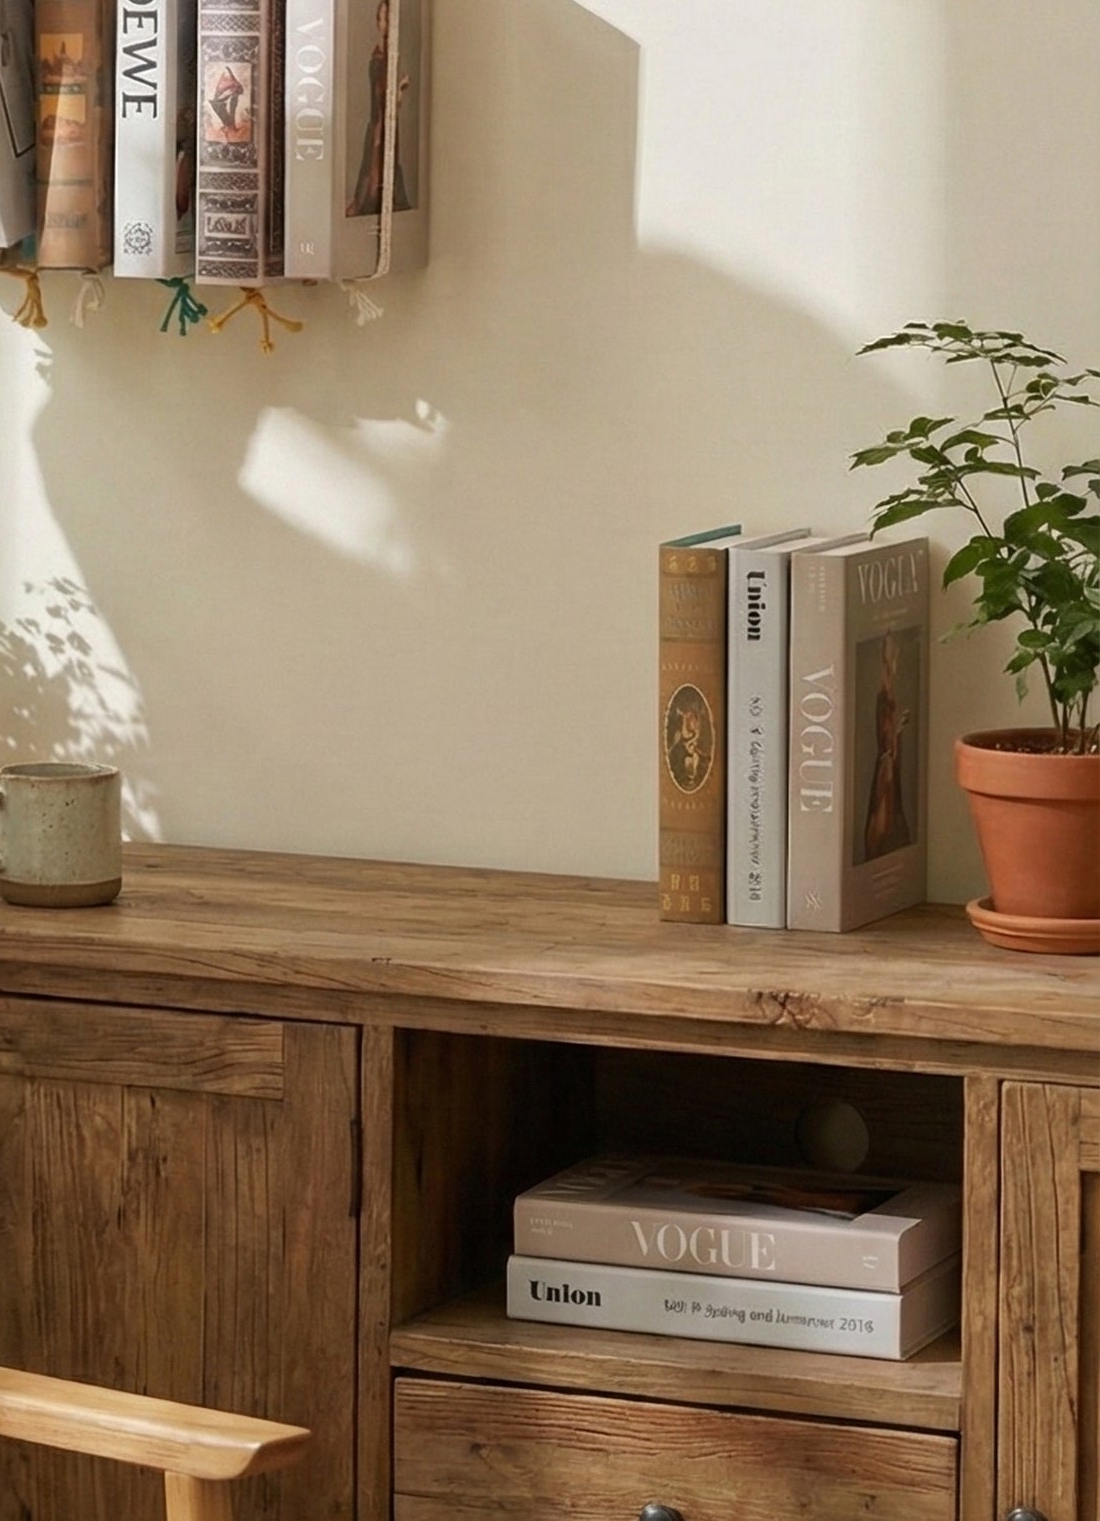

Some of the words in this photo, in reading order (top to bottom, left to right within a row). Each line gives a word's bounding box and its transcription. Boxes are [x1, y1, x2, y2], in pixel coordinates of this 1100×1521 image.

[295, 17, 326, 161] VOGUE
[746, 570, 767, 642] Union
[799, 663, 838, 813] VOGUE
[631, 1220, 776, 1271] VOGUE
